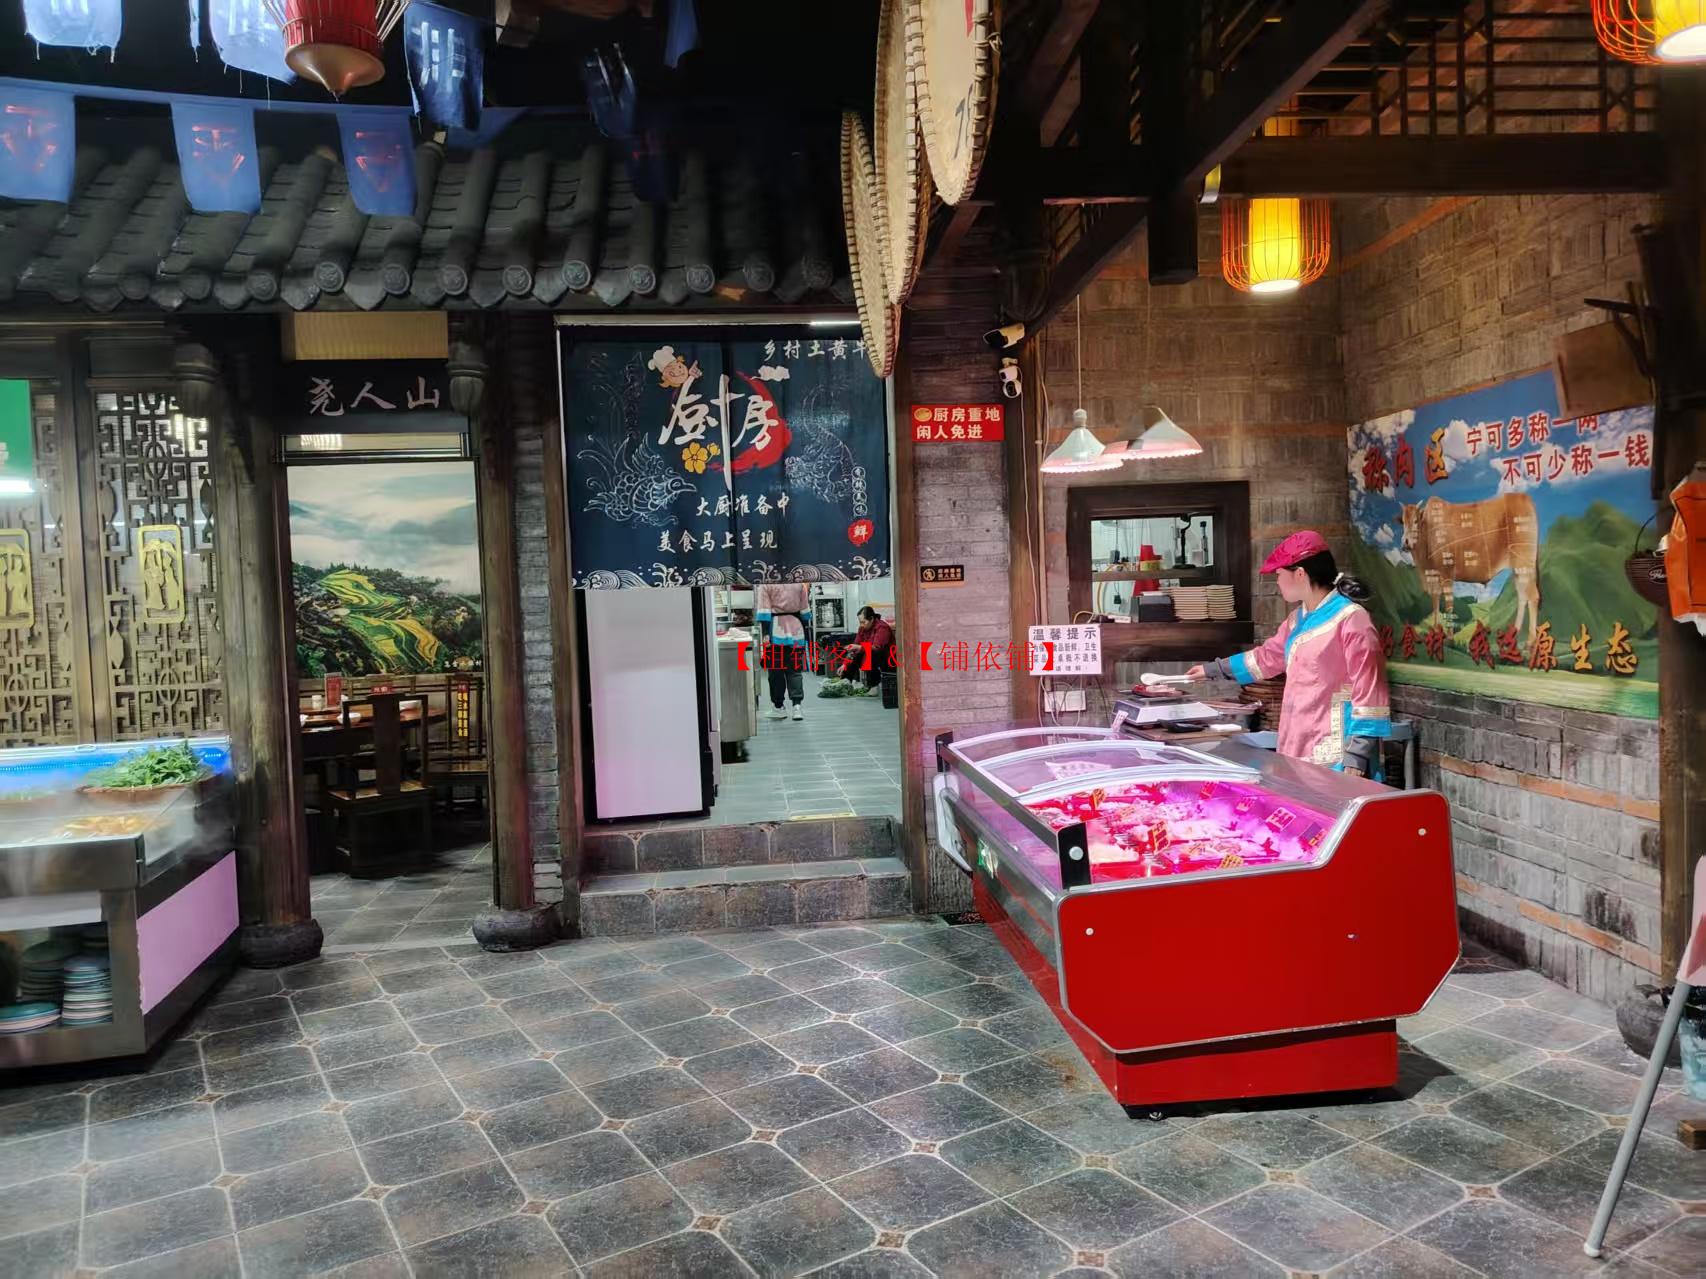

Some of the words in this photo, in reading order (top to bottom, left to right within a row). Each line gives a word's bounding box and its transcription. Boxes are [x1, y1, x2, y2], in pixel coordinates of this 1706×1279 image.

[310, 376, 440, 416] 尧人山
[933, 407, 1000, 422] 厨房重地
[658, 373, 779, 496] 厨房
[916, 424, 982, 440] 闲人免进
[1503, 431, 1650, 486] 不可少称一钱
[696, 492, 790, 517] 大厨准备中
[657, 529, 778, 553] 美食马上呈现
[1033, 627, 1096, 640] 温馨提示
